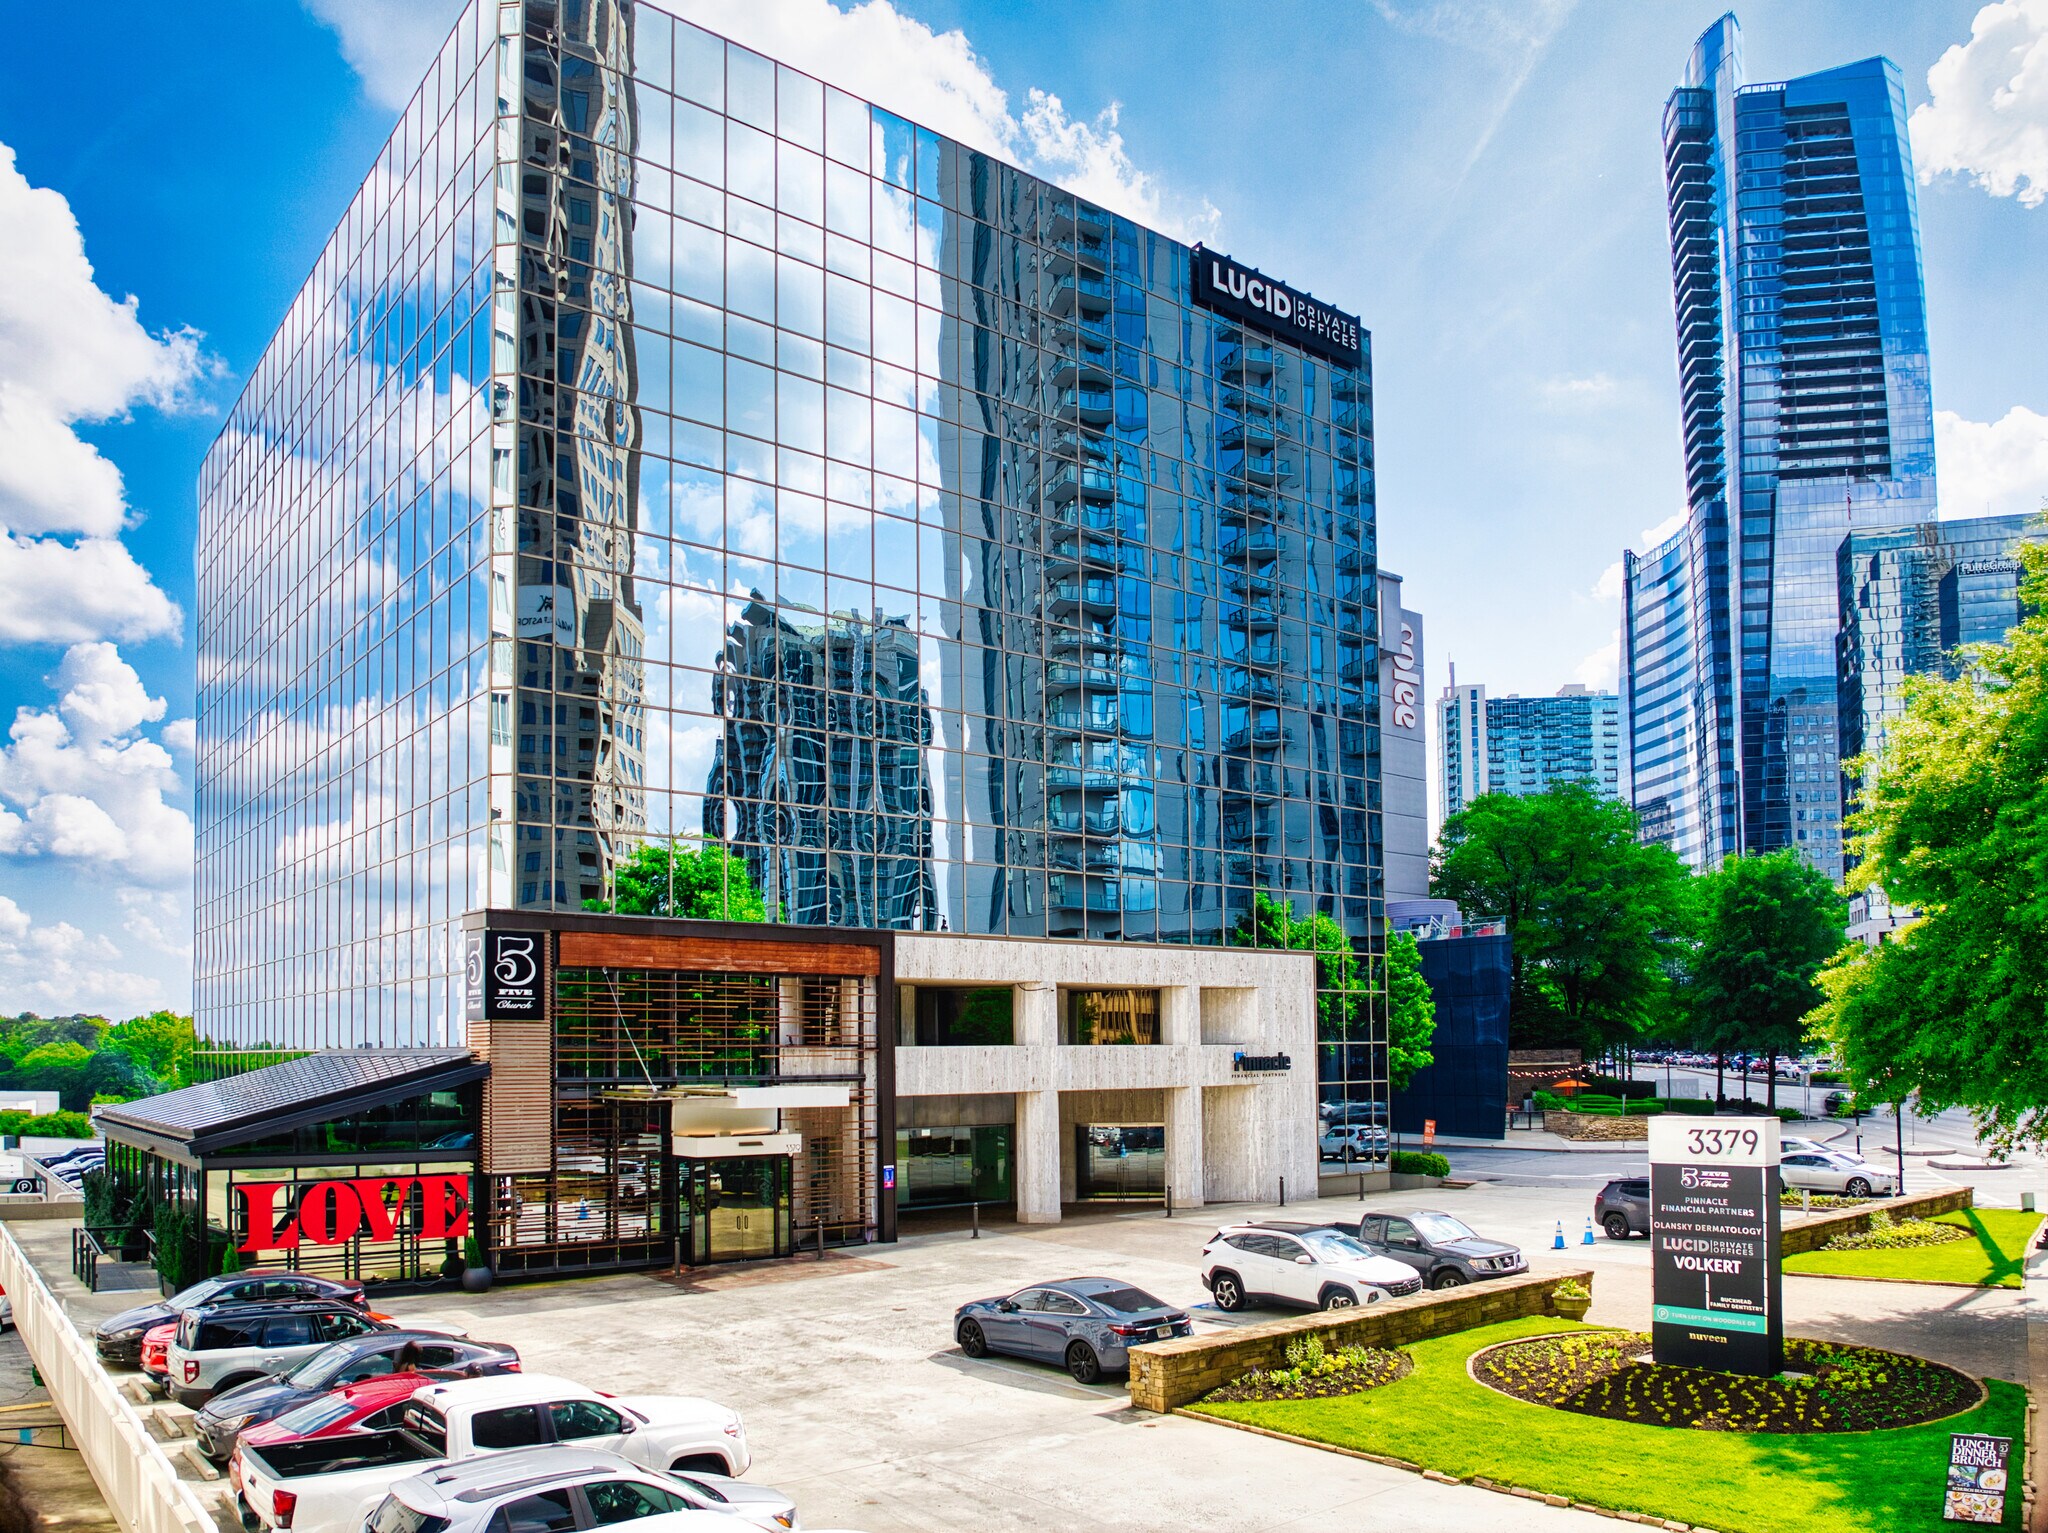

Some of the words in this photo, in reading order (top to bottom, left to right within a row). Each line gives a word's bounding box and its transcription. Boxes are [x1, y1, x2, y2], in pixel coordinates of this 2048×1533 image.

[1213, 261, 1292, 318] LUCID
[1298, 300, 1357, 338] PRIVATE
[1298, 314, 1358, 350] OFFICES
[466, 936, 483, 986] 5
[494, 936, 536, 986] 5
[498, 988, 533, 996] FIVE
[496, 1000, 533, 1009] Church
[1233, 1051, 1291, 1071] Pinnacle
[1688, 1129, 1758, 1155] 3379
[1681, 1167, 1699, 1189] 5
[1700, 1180, 1730, 1188] Church
[1685, 1197, 1728, 1206] PINNACLE
[234, 1174, 468, 1252] LOVE
[1661, 1204, 1707, 1214] FINANCIAL
[1709, 1206, 1755, 1217] PARTNERS
[1654, 1221, 1692, 1231] OLANSKY
[1695, 1225, 1762, 1236] DERMATOLOGY
[1662, 1237, 1709, 1252] LUCID
[1713, 1240, 1754, 1250] PRIVATE
[1713, 1247, 1754, 1256] OFFICES
[1673, 1255, 1742, 1274] VOLKERT
[1720, 1297, 1752, 1305] BUCKHEAD
[1731, 1304, 1763, 1312] DENTISTRY
[1689, 1332, 1728, 1344] nuveen
[1953, 1438, 1995, 1450] LUNCH
[1952, 1446, 1996, 1458] DINNER
[1951, 1454, 2002, 1467] BRUNCH
